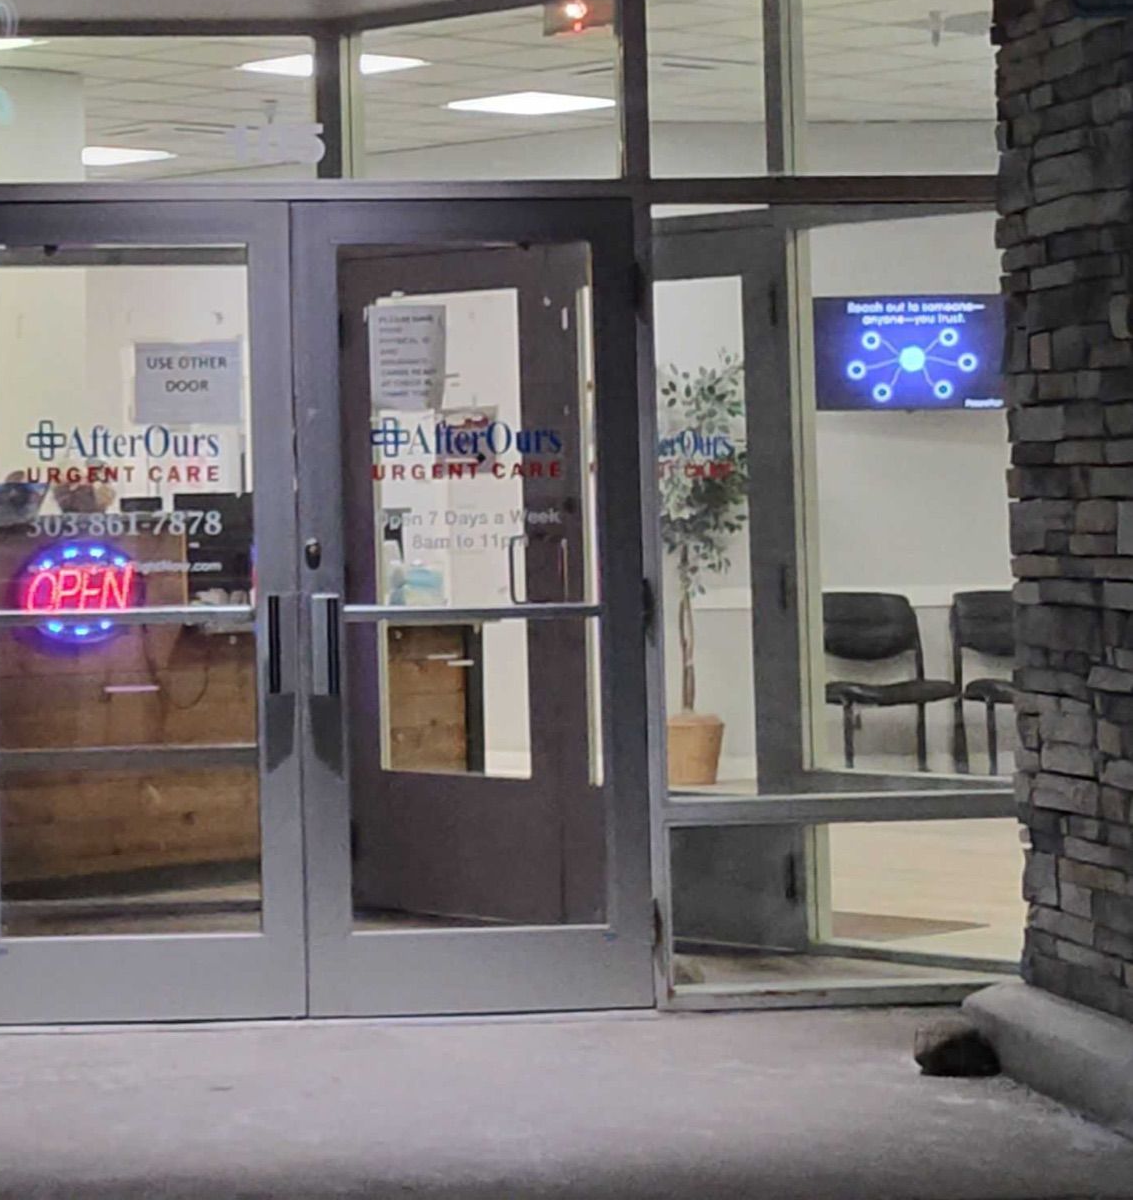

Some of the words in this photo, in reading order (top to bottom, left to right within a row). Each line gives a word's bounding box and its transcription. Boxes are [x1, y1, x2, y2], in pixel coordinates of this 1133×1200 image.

[847, 302, 884, 313] Reach
[886, 302, 906, 313] out
[907, 302, 920, 312] to
[146, 356, 176, 371] USE
[178, 355, 228, 371] OTHER
[165, 379, 209, 393] DOOR
[66, 424, 220, 459] AfterOurs
[408, 420, 562, 456] AfterOurs
[26, 465, 136, 485] URGENT
[148, 464, 220, 484] CARE
[372, 462, 480, 482] URGENT
[492, 460, 562, 479] CARE
[26, 509, 223, 538] 303-861-7878
[429, 511, 439, 525] 7
[445, 511, 489, 528] Days
[494, 513, 505, 525] a
[509, 509, 562, 525] Week
[412, 536, 450, 550] 8am
[457, 535, 473, 548] to
[25, 562, 134, 612] OPEN
